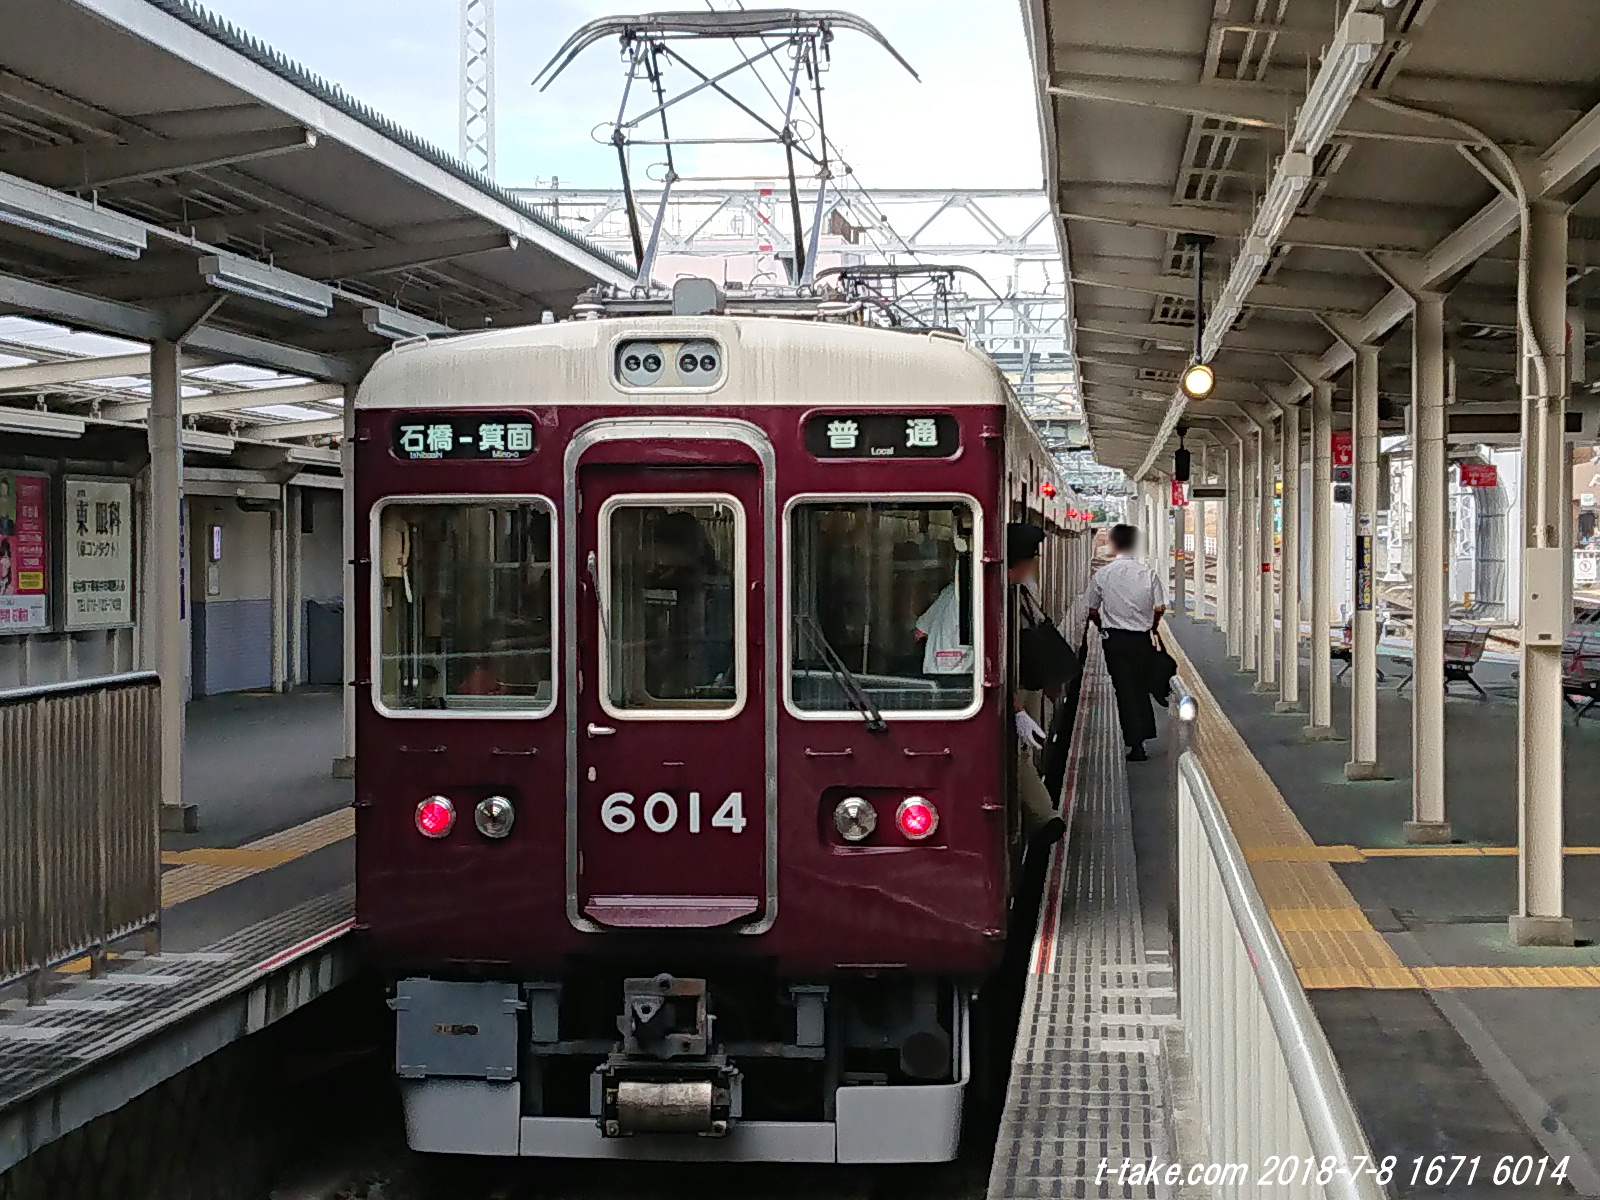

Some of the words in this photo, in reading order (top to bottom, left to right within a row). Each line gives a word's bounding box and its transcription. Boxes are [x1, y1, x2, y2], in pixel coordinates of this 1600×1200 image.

[826, 418, 939, 449] 普通
[870, 446, 895, 456] Local
[600, 792, 747, 834] 6014
